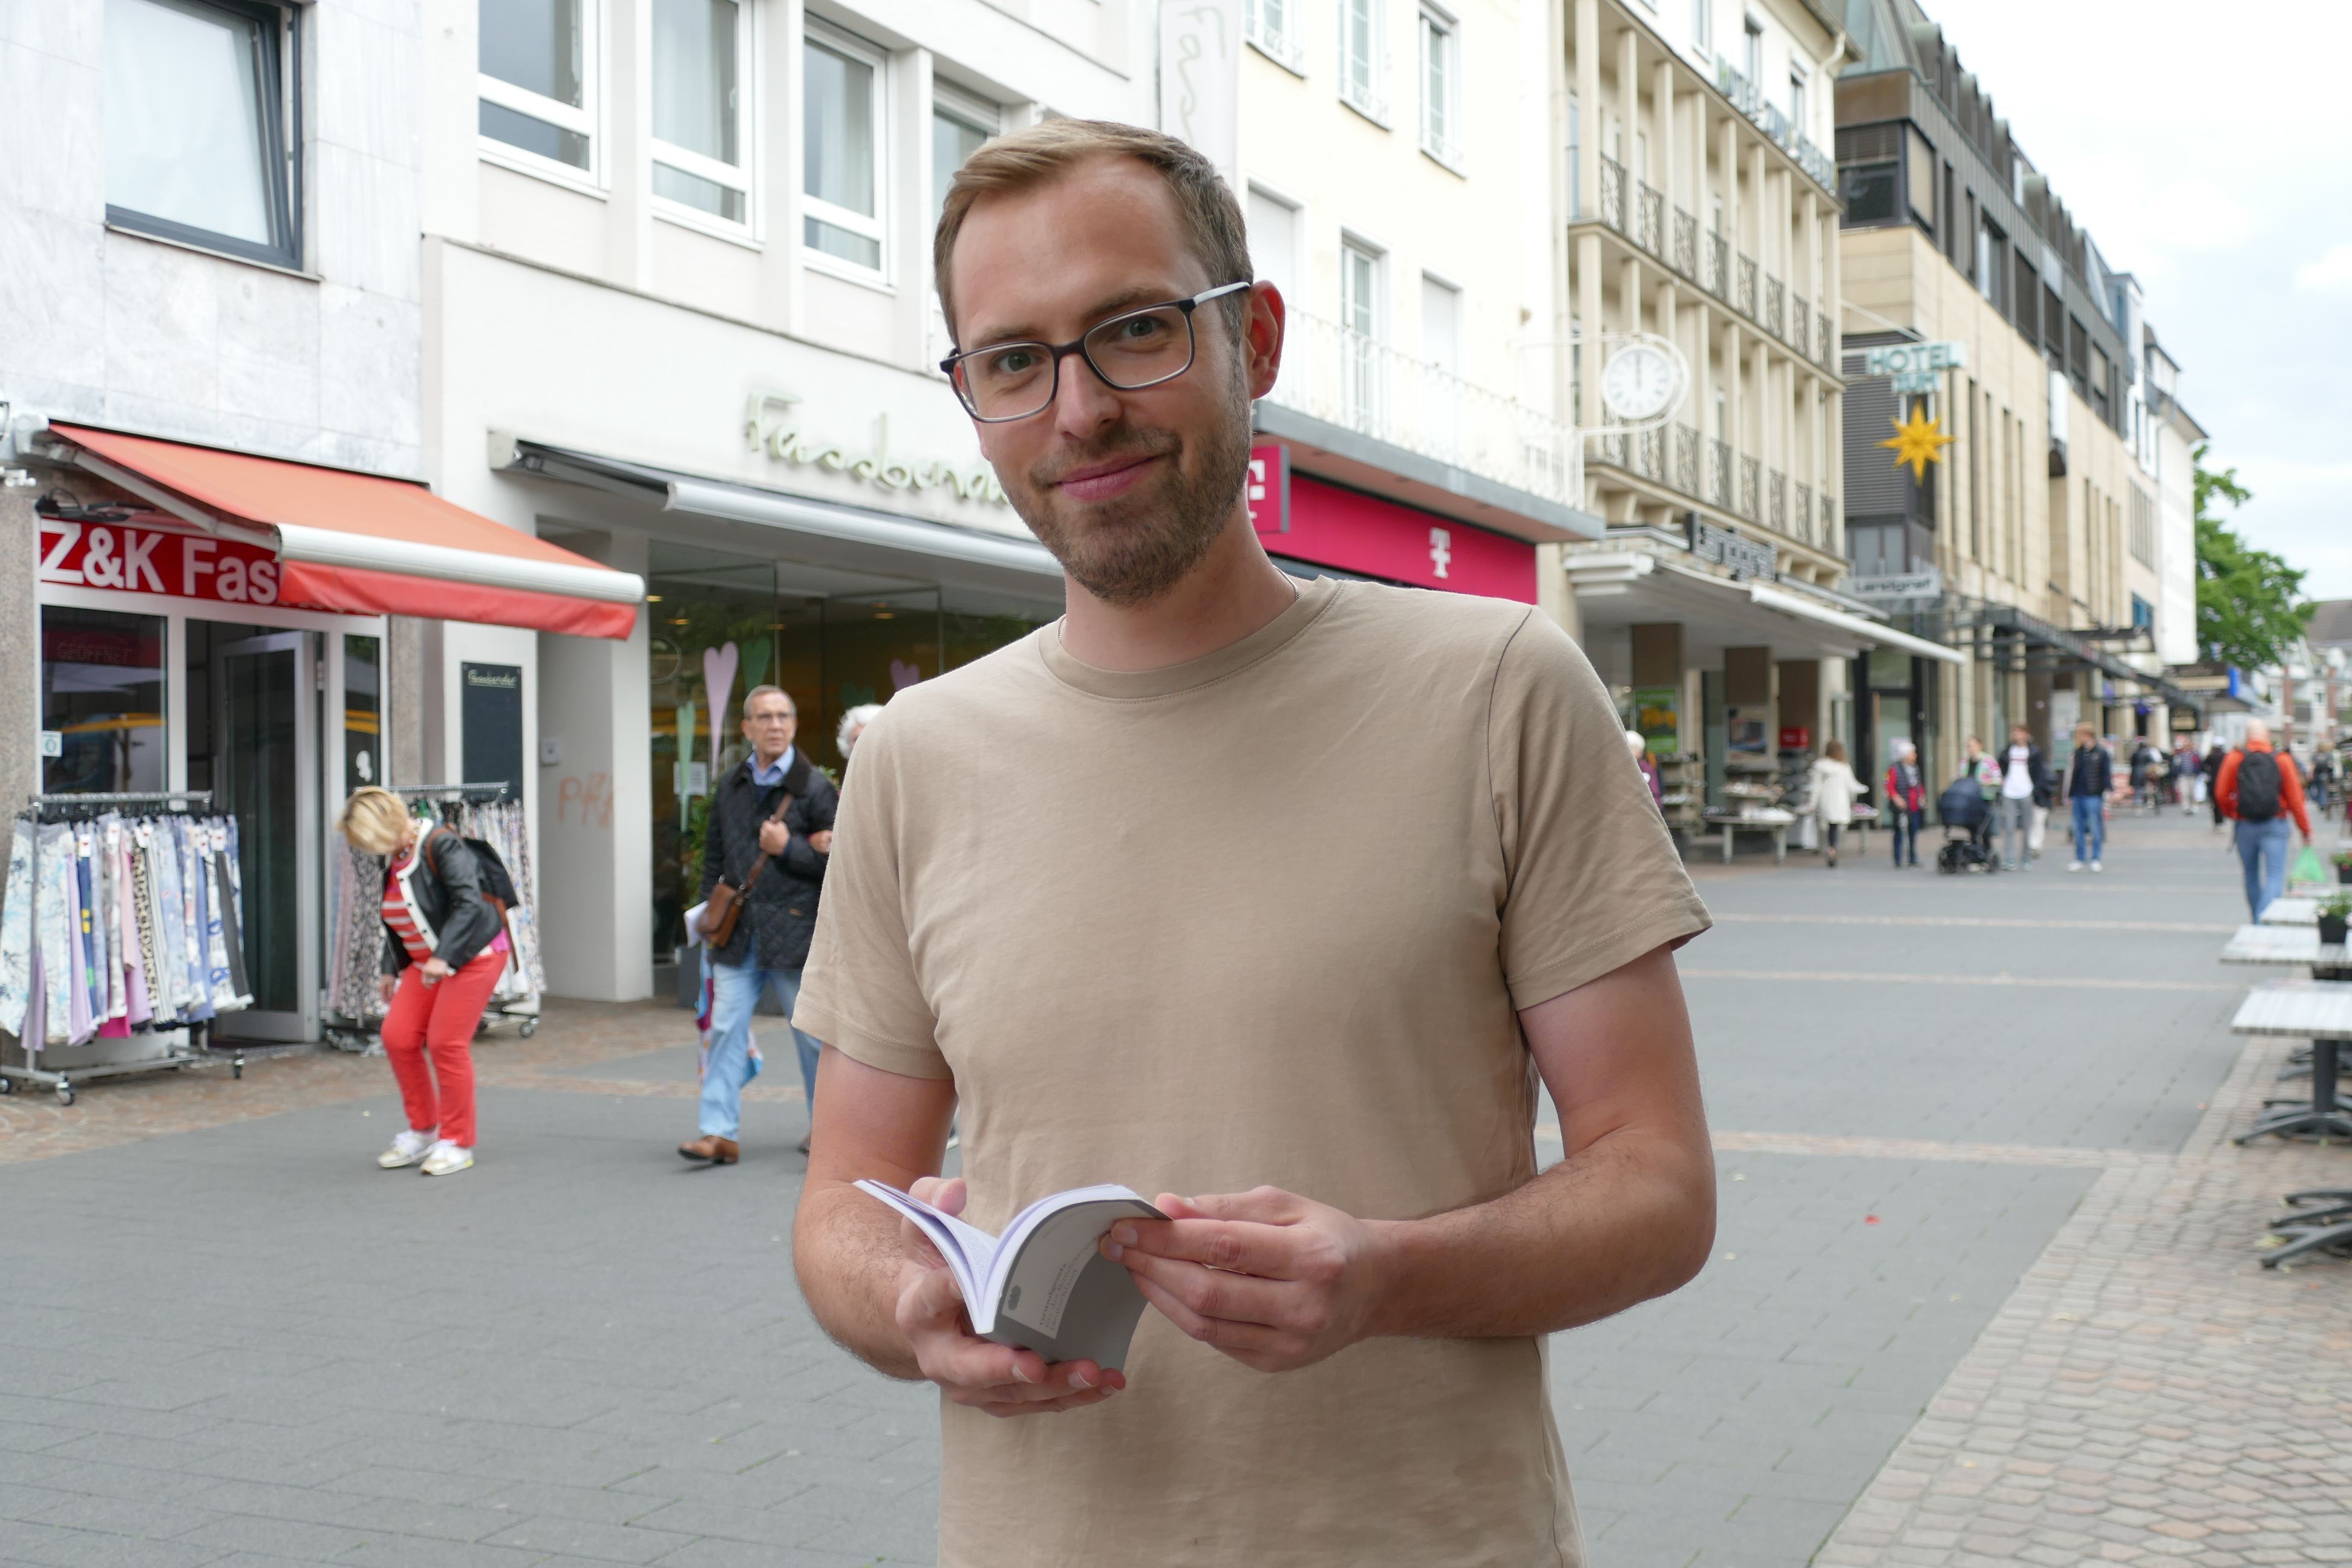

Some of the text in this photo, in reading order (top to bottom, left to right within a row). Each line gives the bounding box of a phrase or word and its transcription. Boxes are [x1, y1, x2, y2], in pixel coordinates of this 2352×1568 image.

[1868, 342, 1963, 375] HOTEL
[40, 523, 167, 593] Z&K
[1039, 1262, 1067, 1326] Grundgesetz
